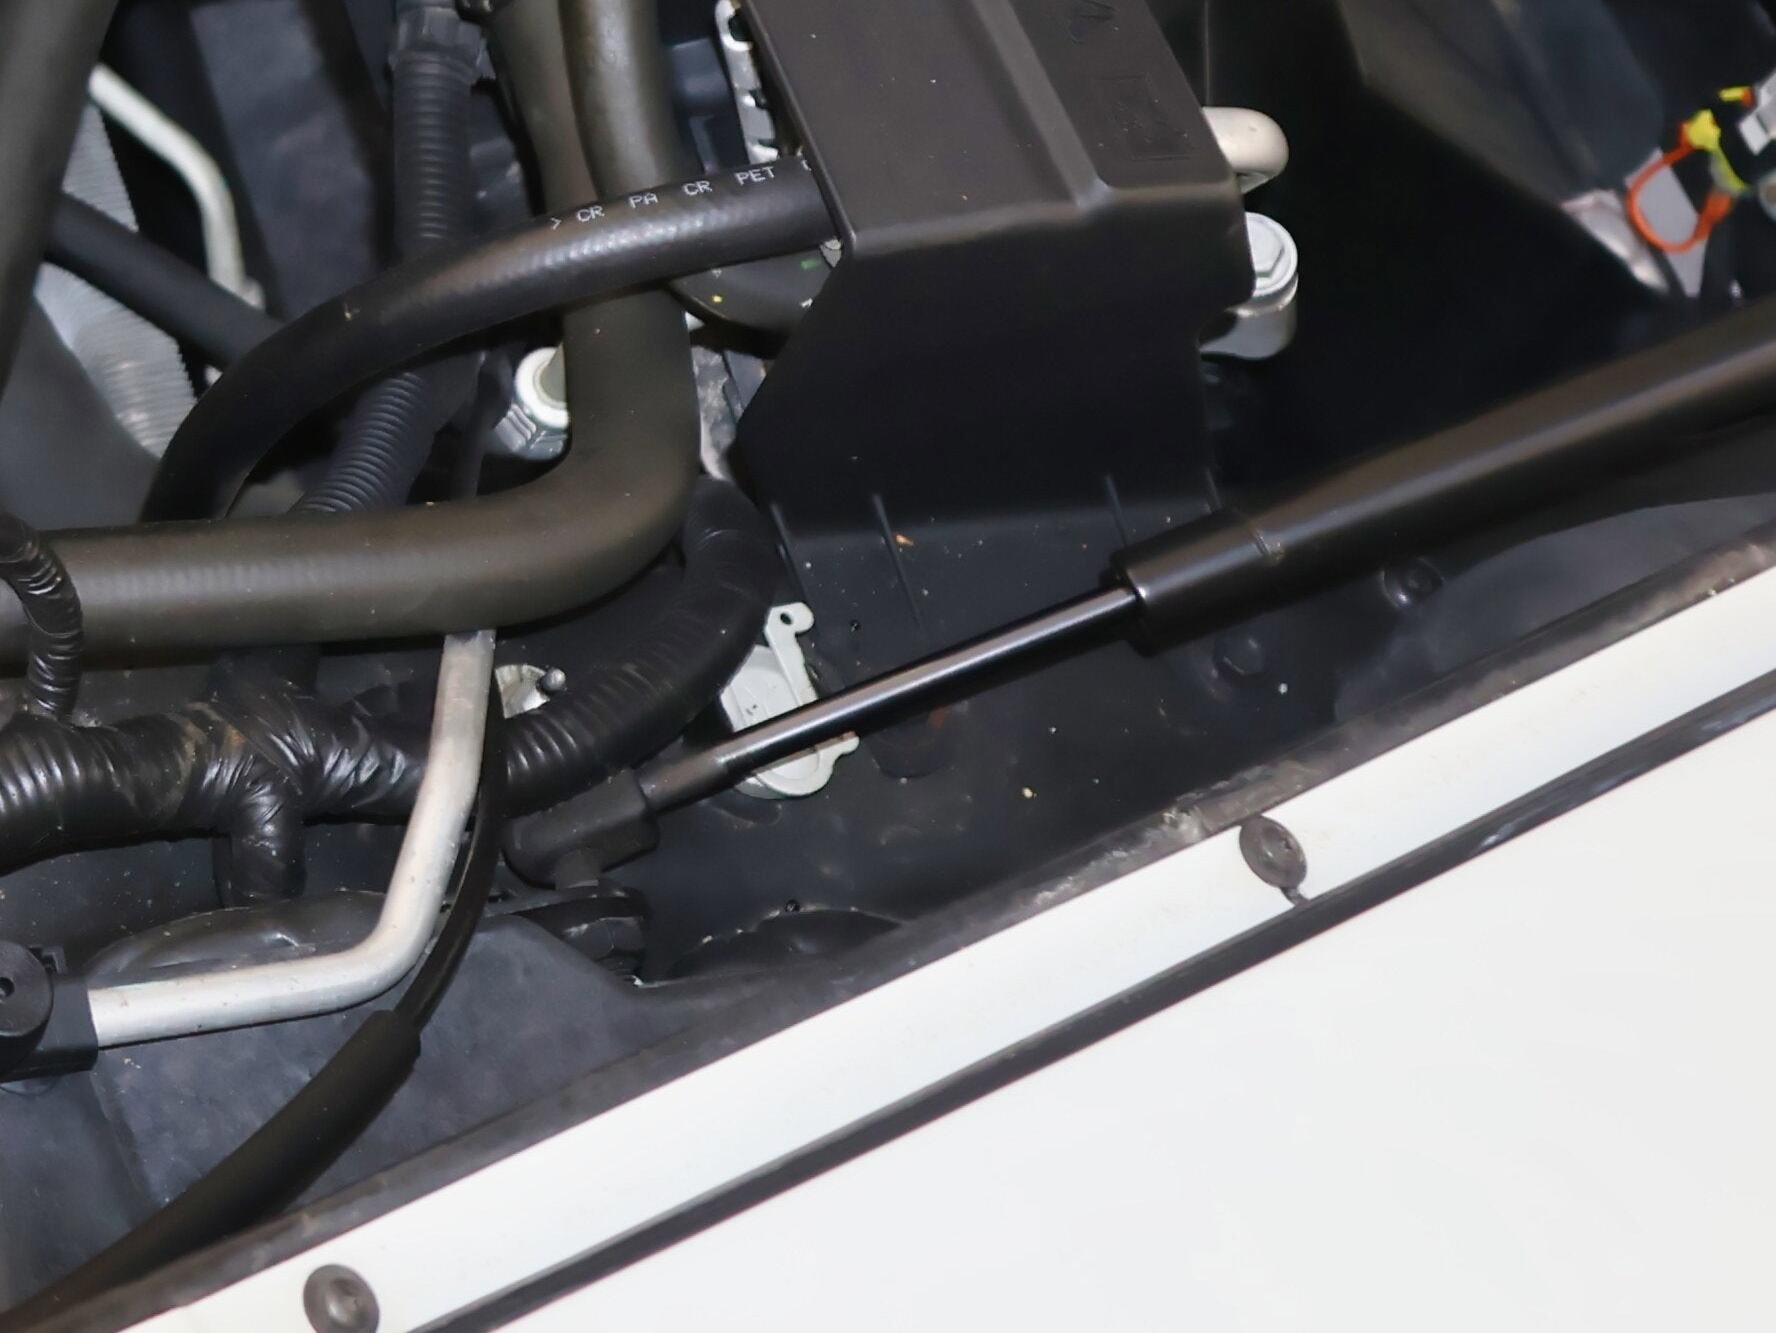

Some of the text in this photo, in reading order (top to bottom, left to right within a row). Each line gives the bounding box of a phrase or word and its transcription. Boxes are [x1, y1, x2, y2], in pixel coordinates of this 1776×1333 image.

[576, 166, 777, 224] CR PA CR PET
